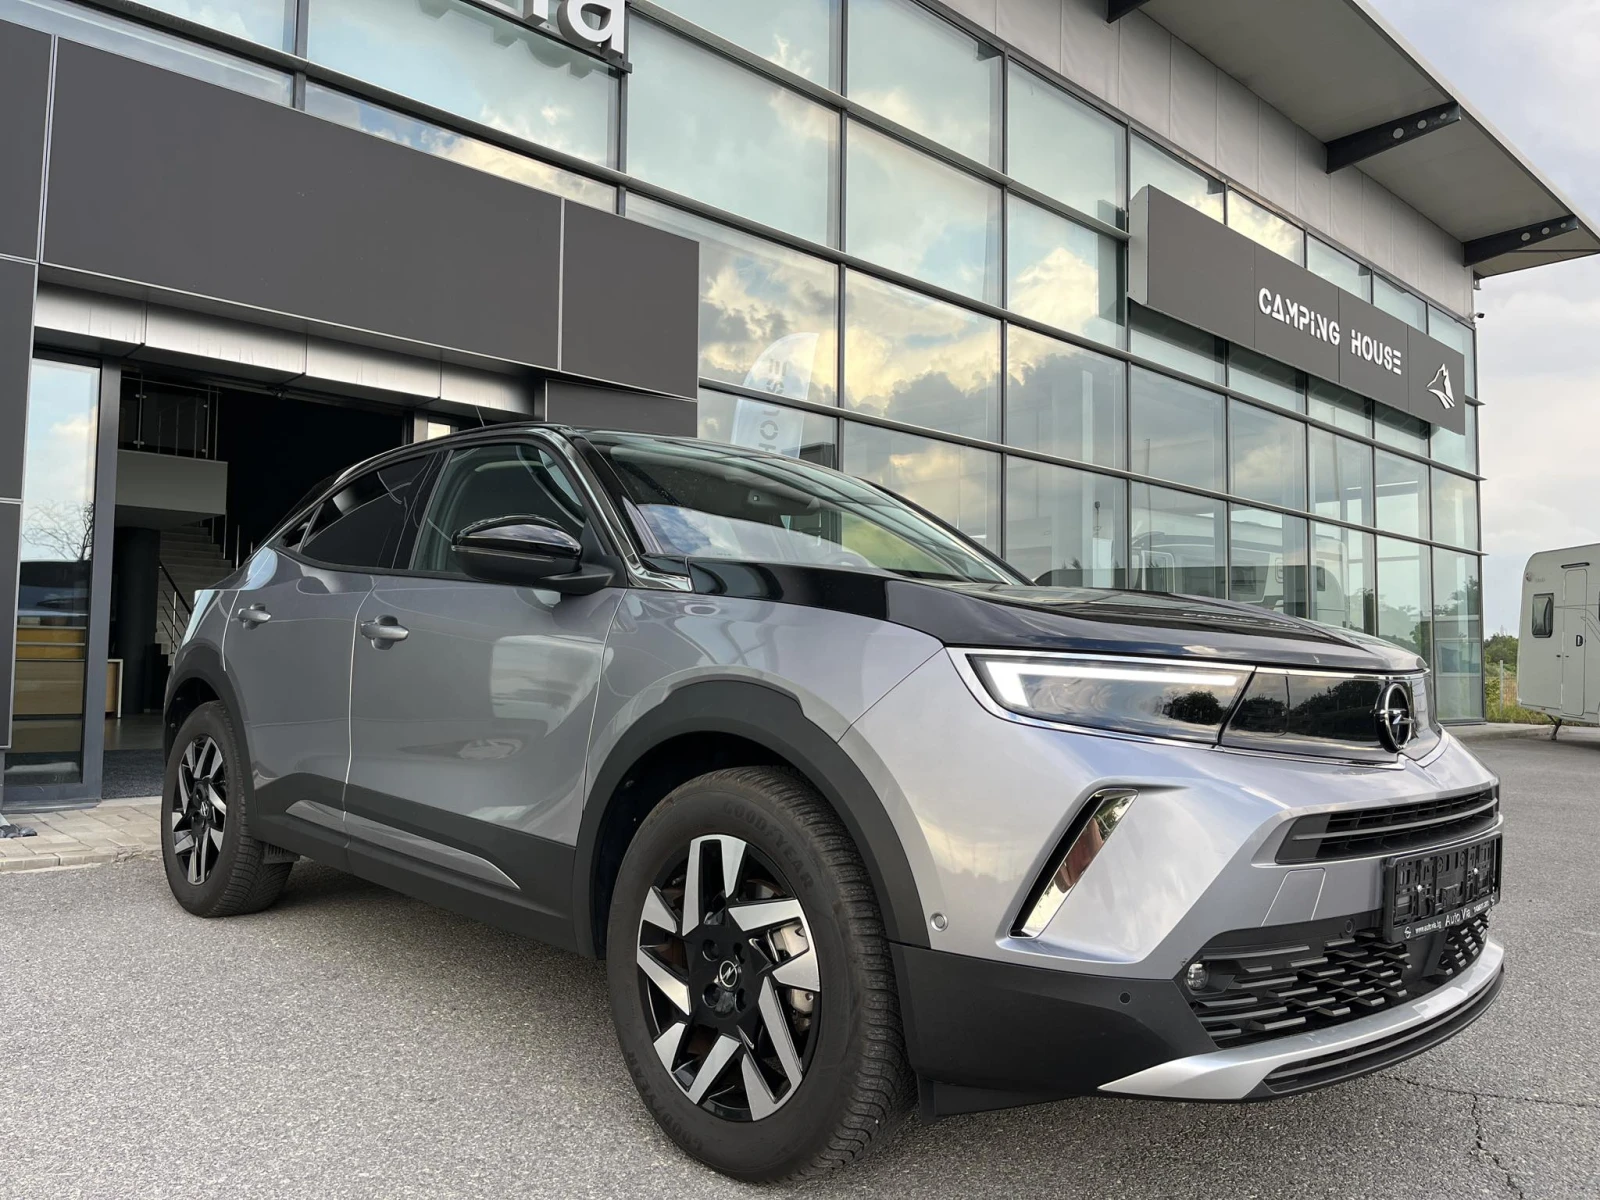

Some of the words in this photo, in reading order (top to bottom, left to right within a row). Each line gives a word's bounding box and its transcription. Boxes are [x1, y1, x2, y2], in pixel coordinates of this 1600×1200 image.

[1351, 329, 1401, 375] HOUSE
[1445, 911, 1460, 926] Auto
[1461, 907, 1471, 919] Via
